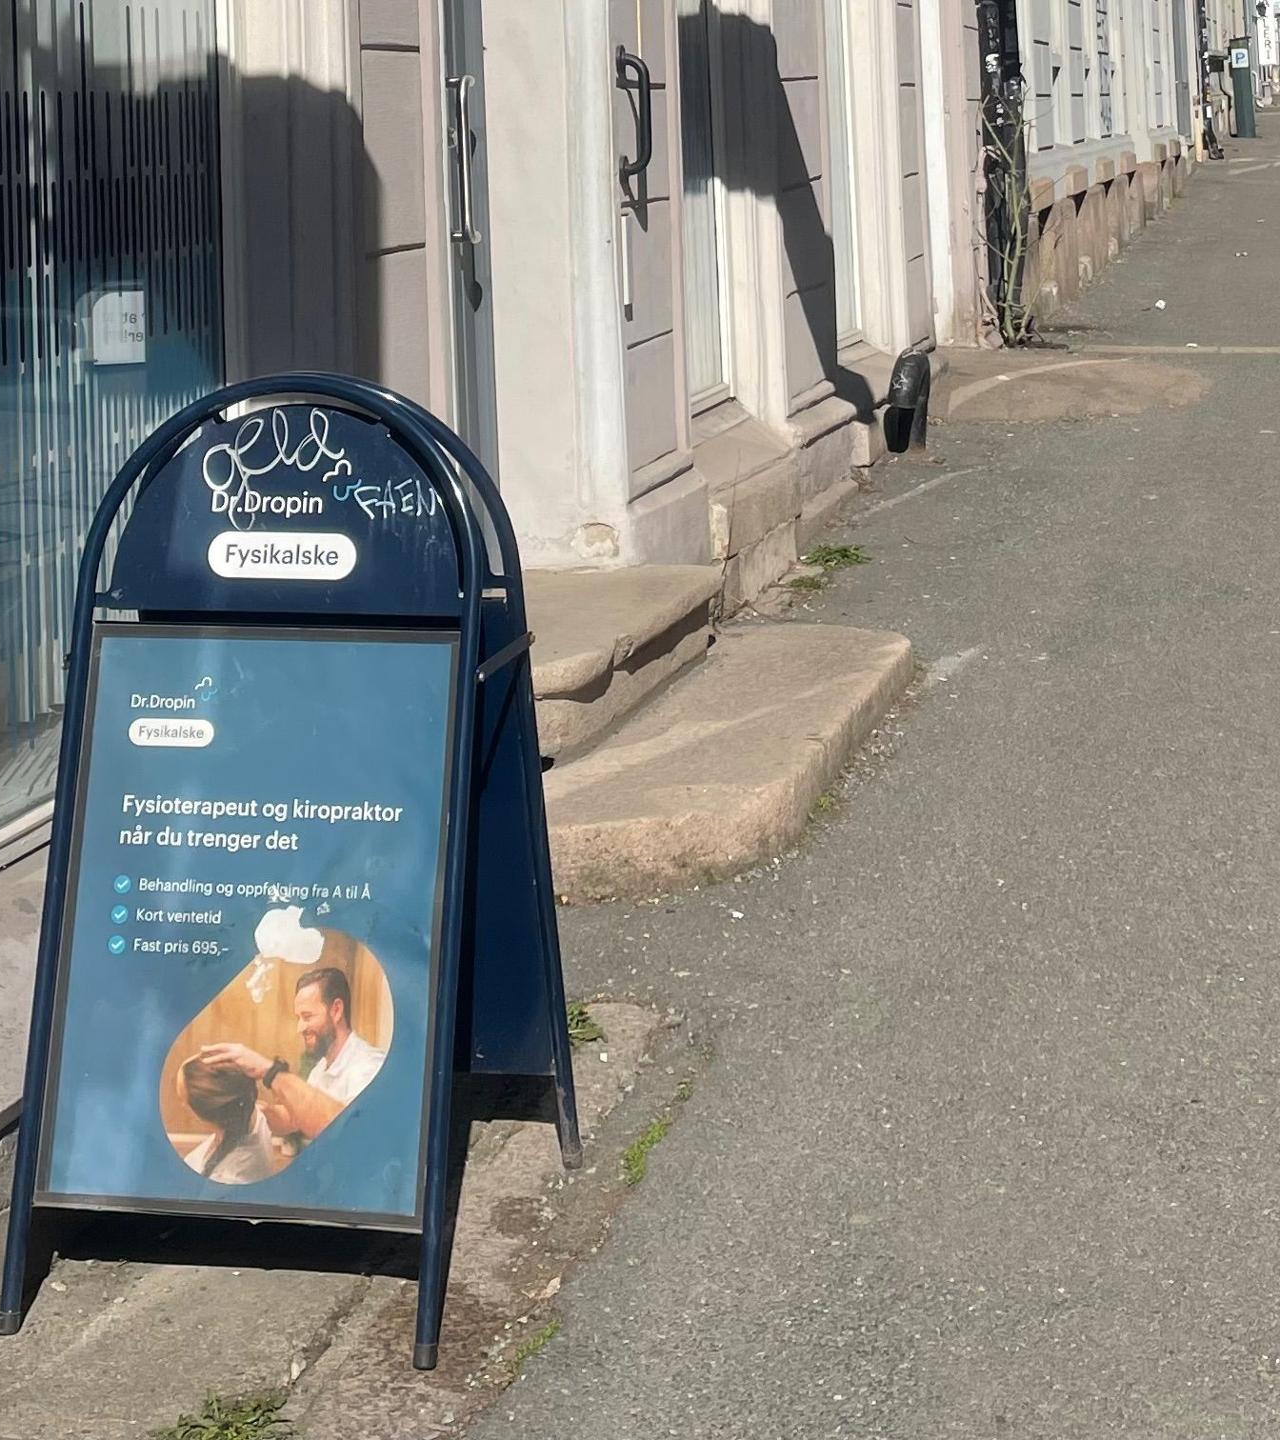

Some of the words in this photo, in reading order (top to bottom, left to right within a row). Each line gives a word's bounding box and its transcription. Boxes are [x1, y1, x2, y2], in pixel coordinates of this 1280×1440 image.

[210, 490, 324, 518] Dr.Dropin
[225, 543, 339, 568] Fysikalske
[130, 694, 196, 711] Dr.Dropin
[138, 725, 205, 741] Fysikalske
[122, 794, 258, 819] Fysioterapeut
[262, 801, 288, 822] og
[292, 799, 403, 824] kiropraktor
[119, 825, 152, 845] når
[156, 826, 182, 847] du
[186, 830, 260, 852] trenger
[265, 830, 299, 850] det
[138, 878, 213, 896] Behandling
[215, 883, 233, 897] og
[312, 885, 330, 898] fra
[332, 886, 342, 898] A
[345, 886, 358, 899] til
[361, 883, 371, 900] Å
[135, 908, 164, 922] Kort
[168, 909, 222, 924] ventetid
[133, 938, 161, 953] Fast
[164, 939, 189, 956] pris
